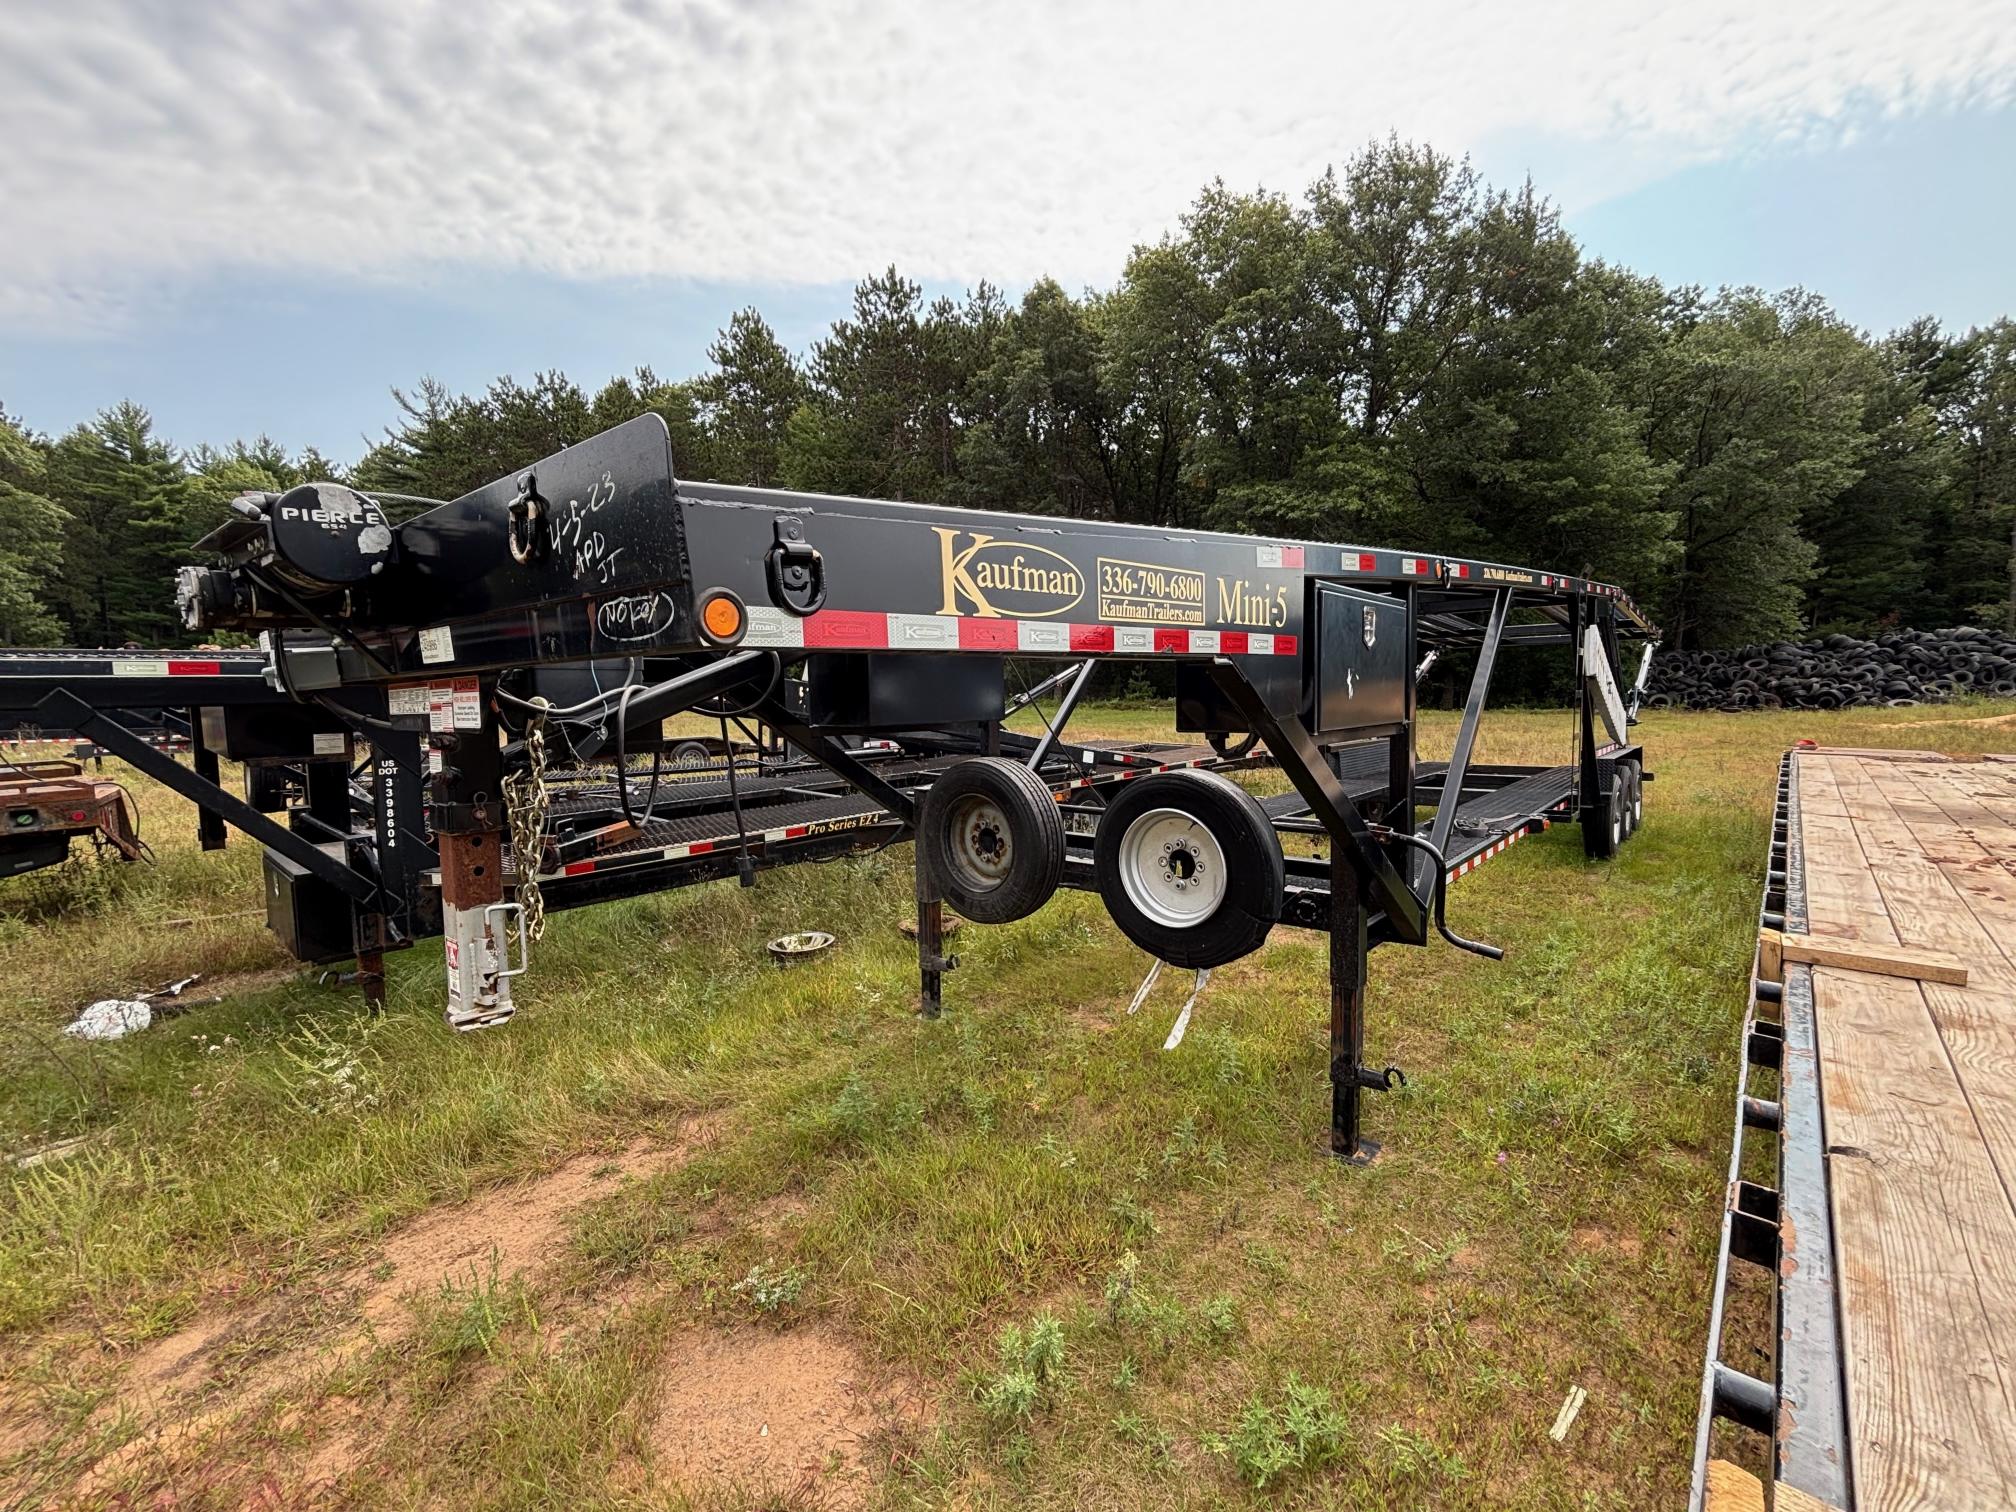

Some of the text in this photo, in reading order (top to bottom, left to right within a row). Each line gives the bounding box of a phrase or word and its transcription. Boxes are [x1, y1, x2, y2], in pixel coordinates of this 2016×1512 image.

[281, 507, 380, 525] PIERCE
[931, 526, 1079, 618] Kaufman
[1102, 565, 1202, 601] 336-790-6800
[1101, 599, 1202, 622] KaufmanTrailers.com
[1216, 576, 1287, 628] Mini-5
[378, 767, 398, 775] DOT
[385, 778, 395, 848] 3398604
[808, 824, 826, 835] Pro
[828, 818, 857, 832] Series
